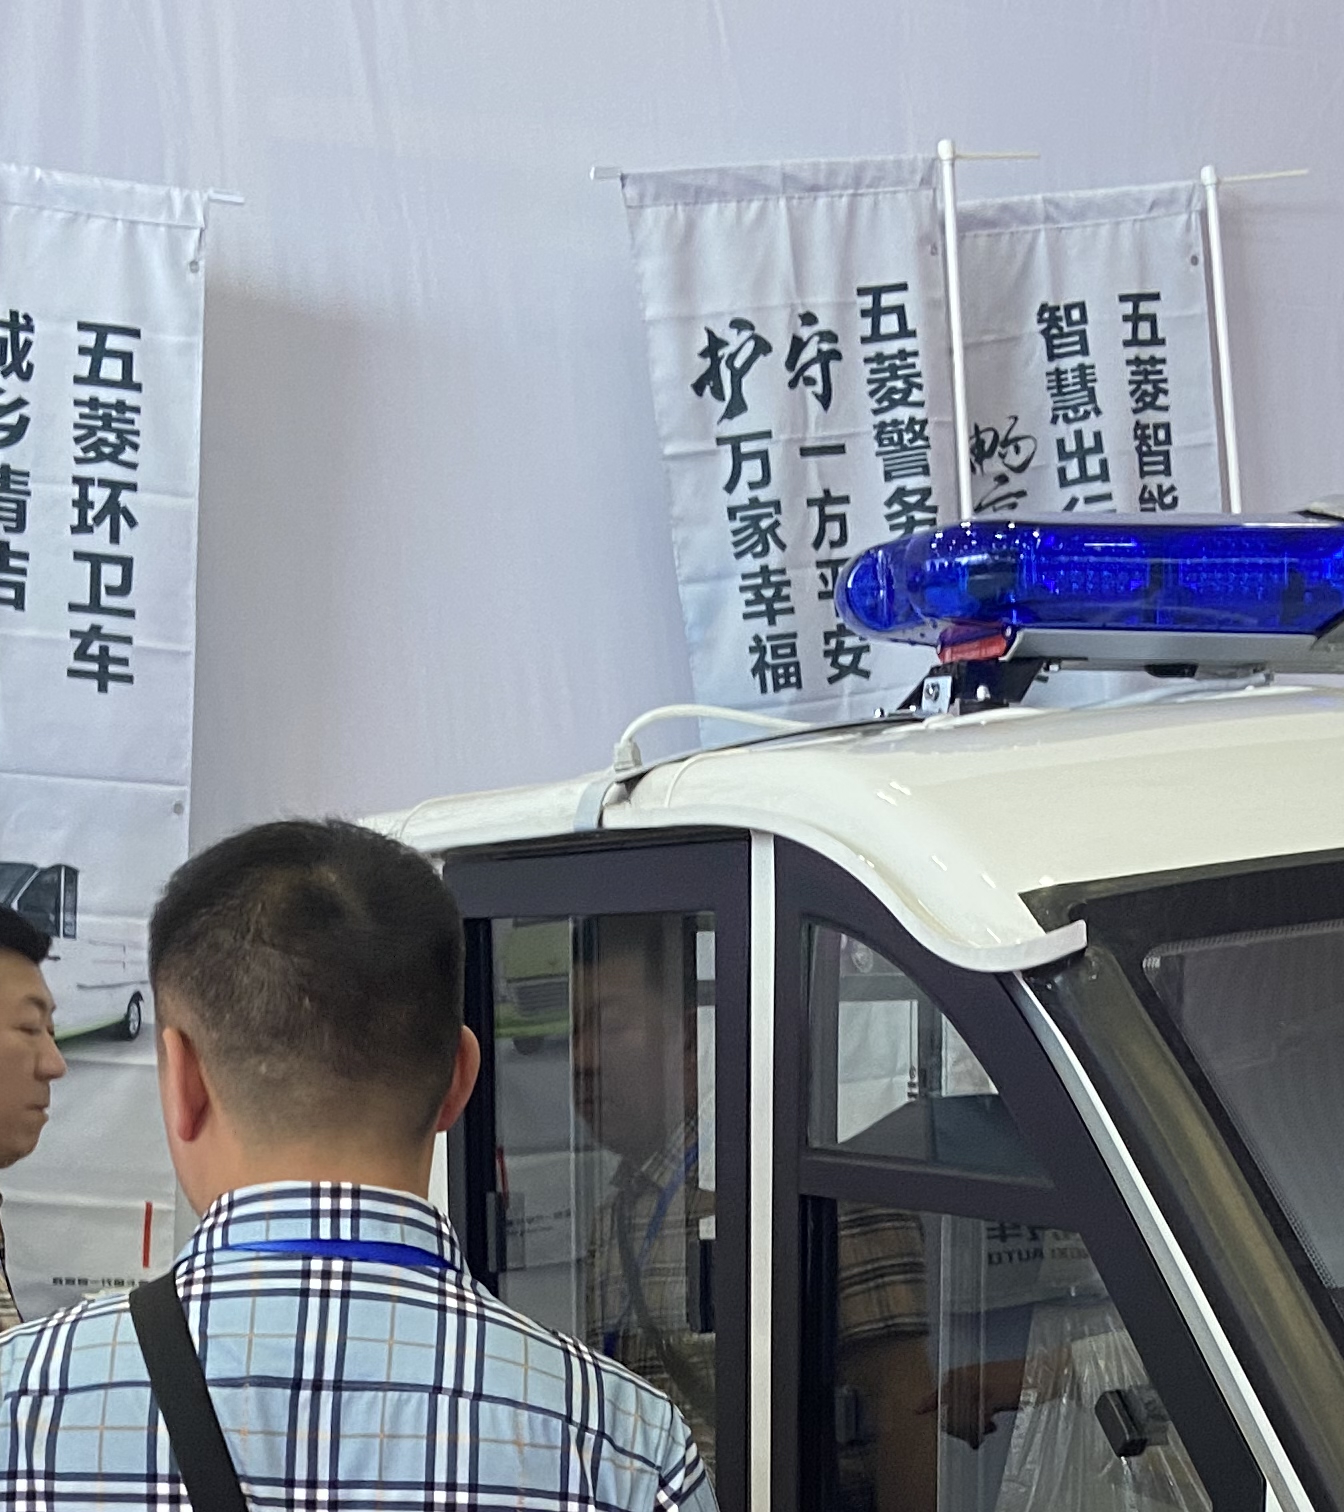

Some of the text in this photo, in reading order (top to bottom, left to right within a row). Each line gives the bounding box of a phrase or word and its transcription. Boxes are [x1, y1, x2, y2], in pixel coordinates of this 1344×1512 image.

[66, 320, 143, 693] 五菱环卫车
[691, 318, 803, 694] 护万家幸福
